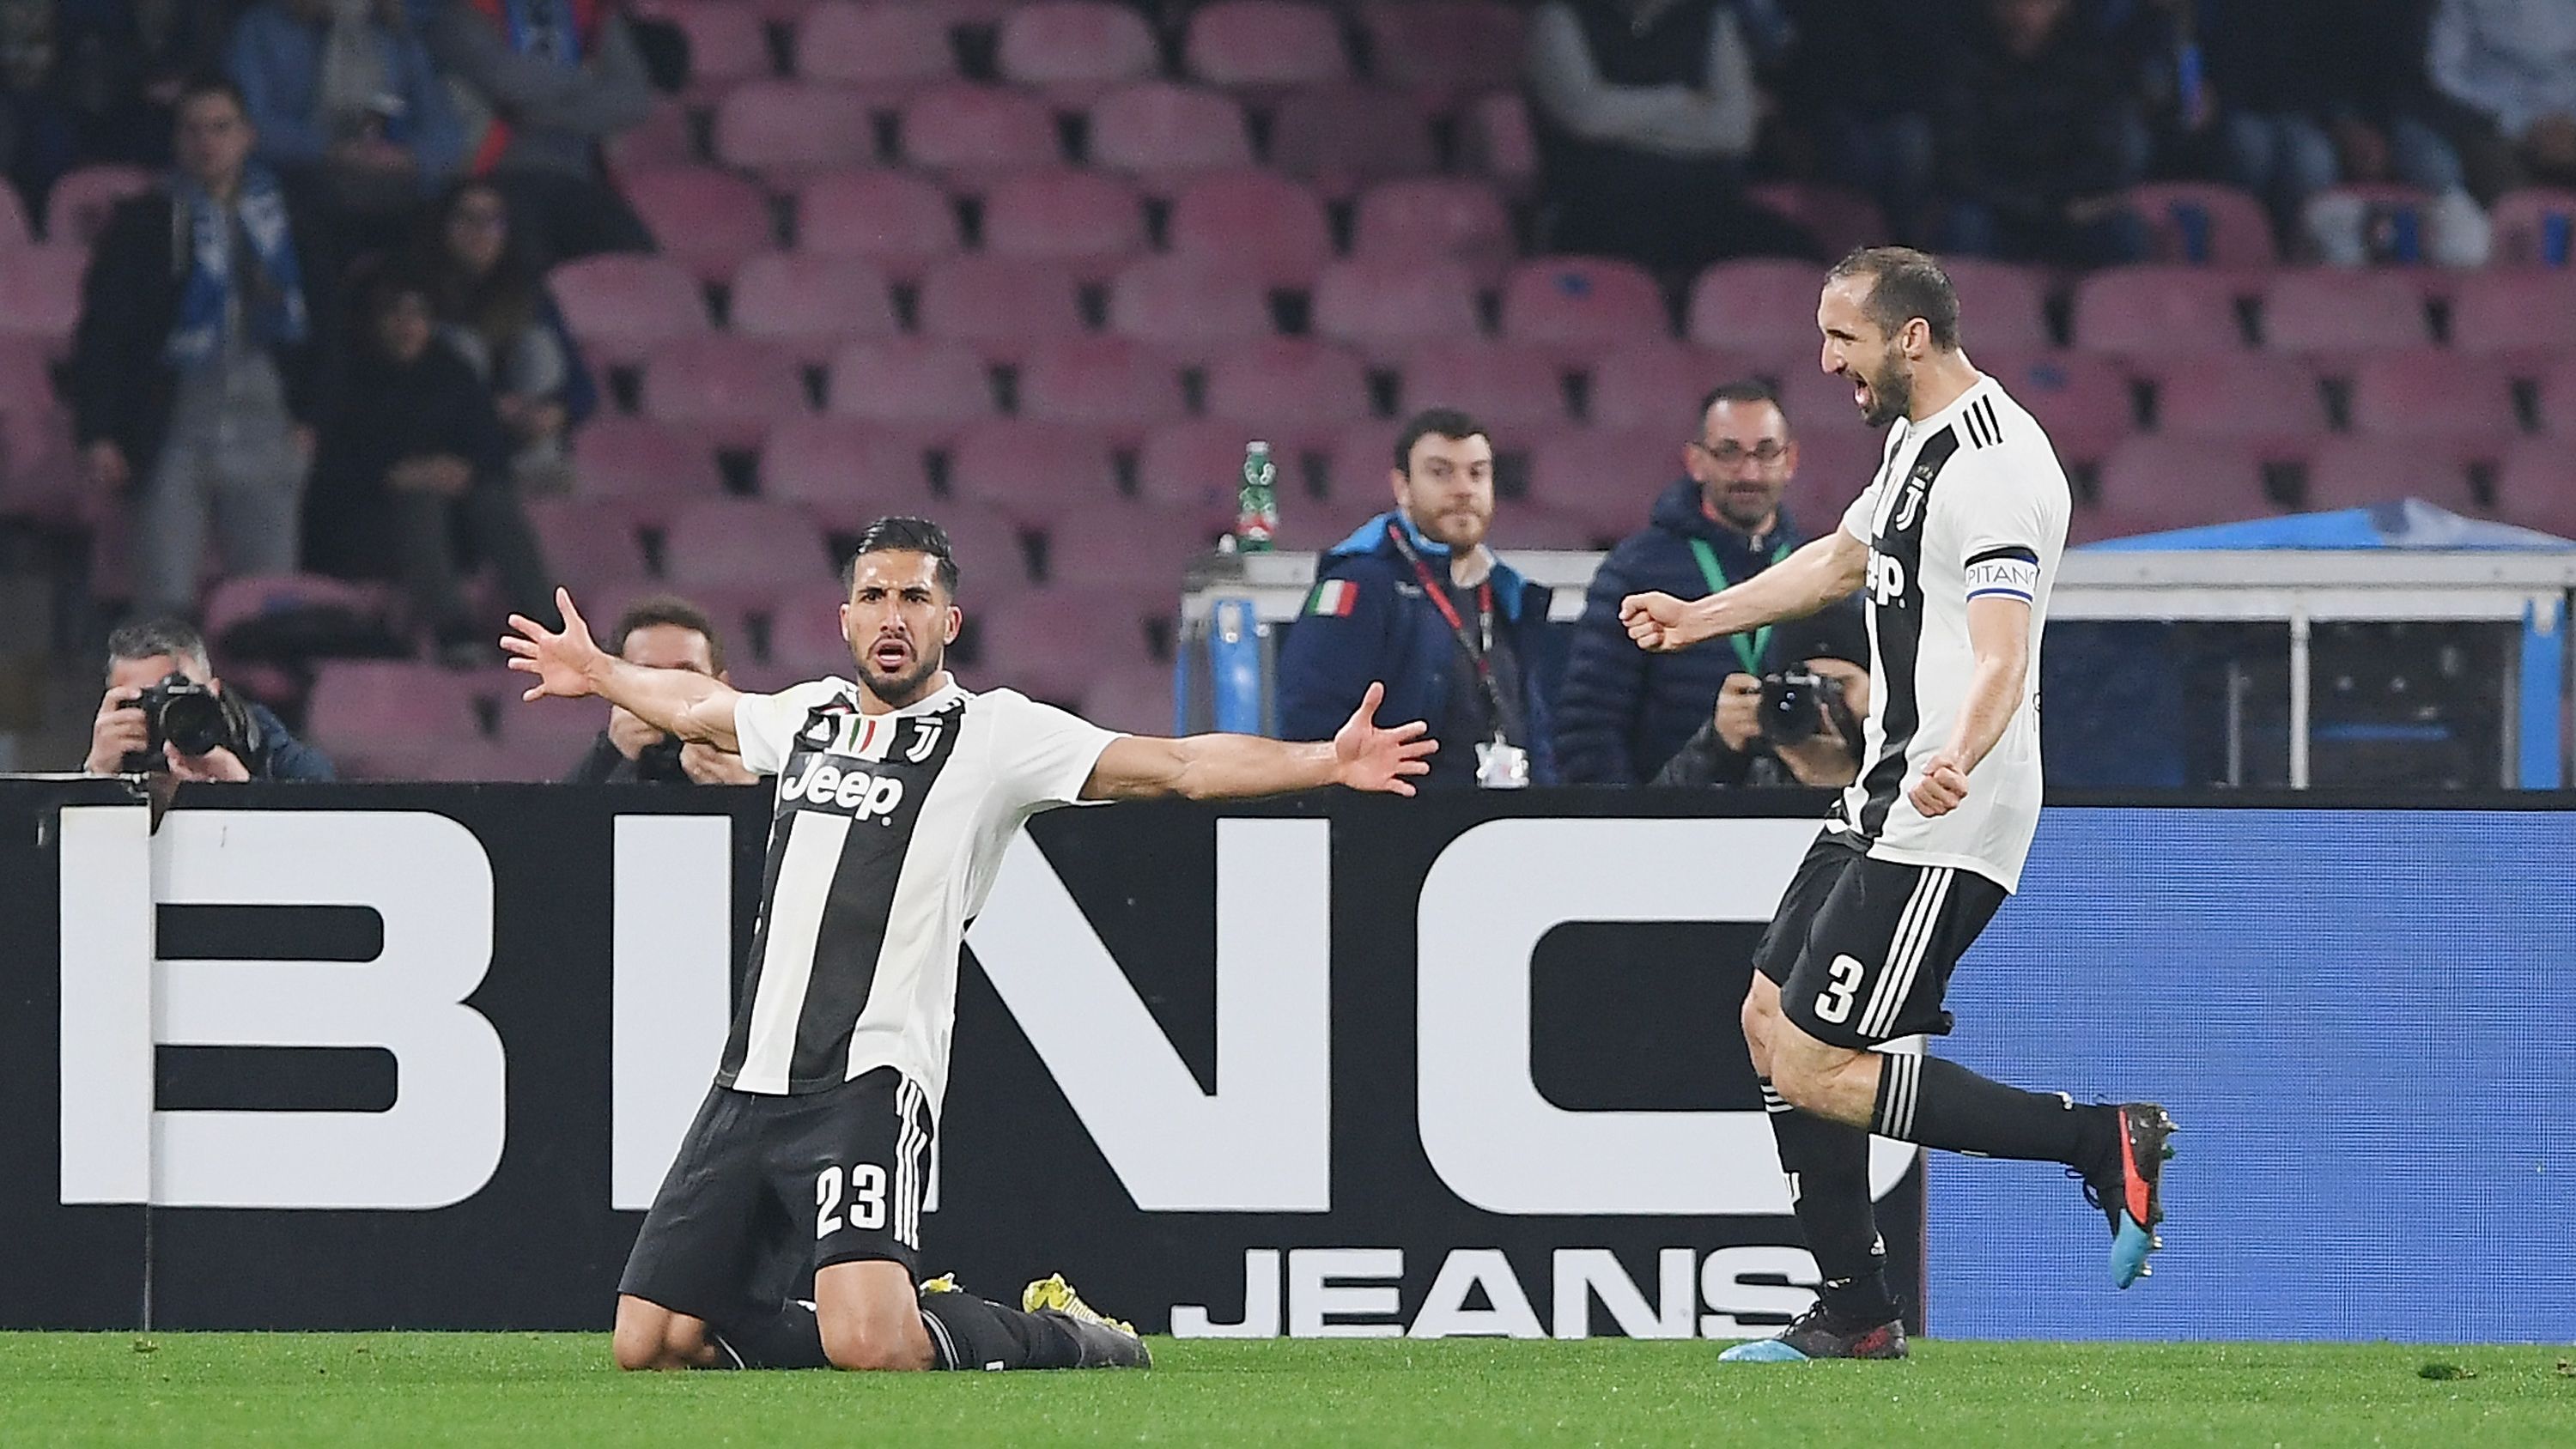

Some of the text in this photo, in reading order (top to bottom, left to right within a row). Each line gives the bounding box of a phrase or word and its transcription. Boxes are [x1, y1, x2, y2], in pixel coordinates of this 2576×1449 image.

[782, 752, 903, 822] Jeep
[1814, 953, 1864, 1024] 3
[816, 1163, 887, 1240] 23
[1170, 1247, 1824, 1340] JEANS
